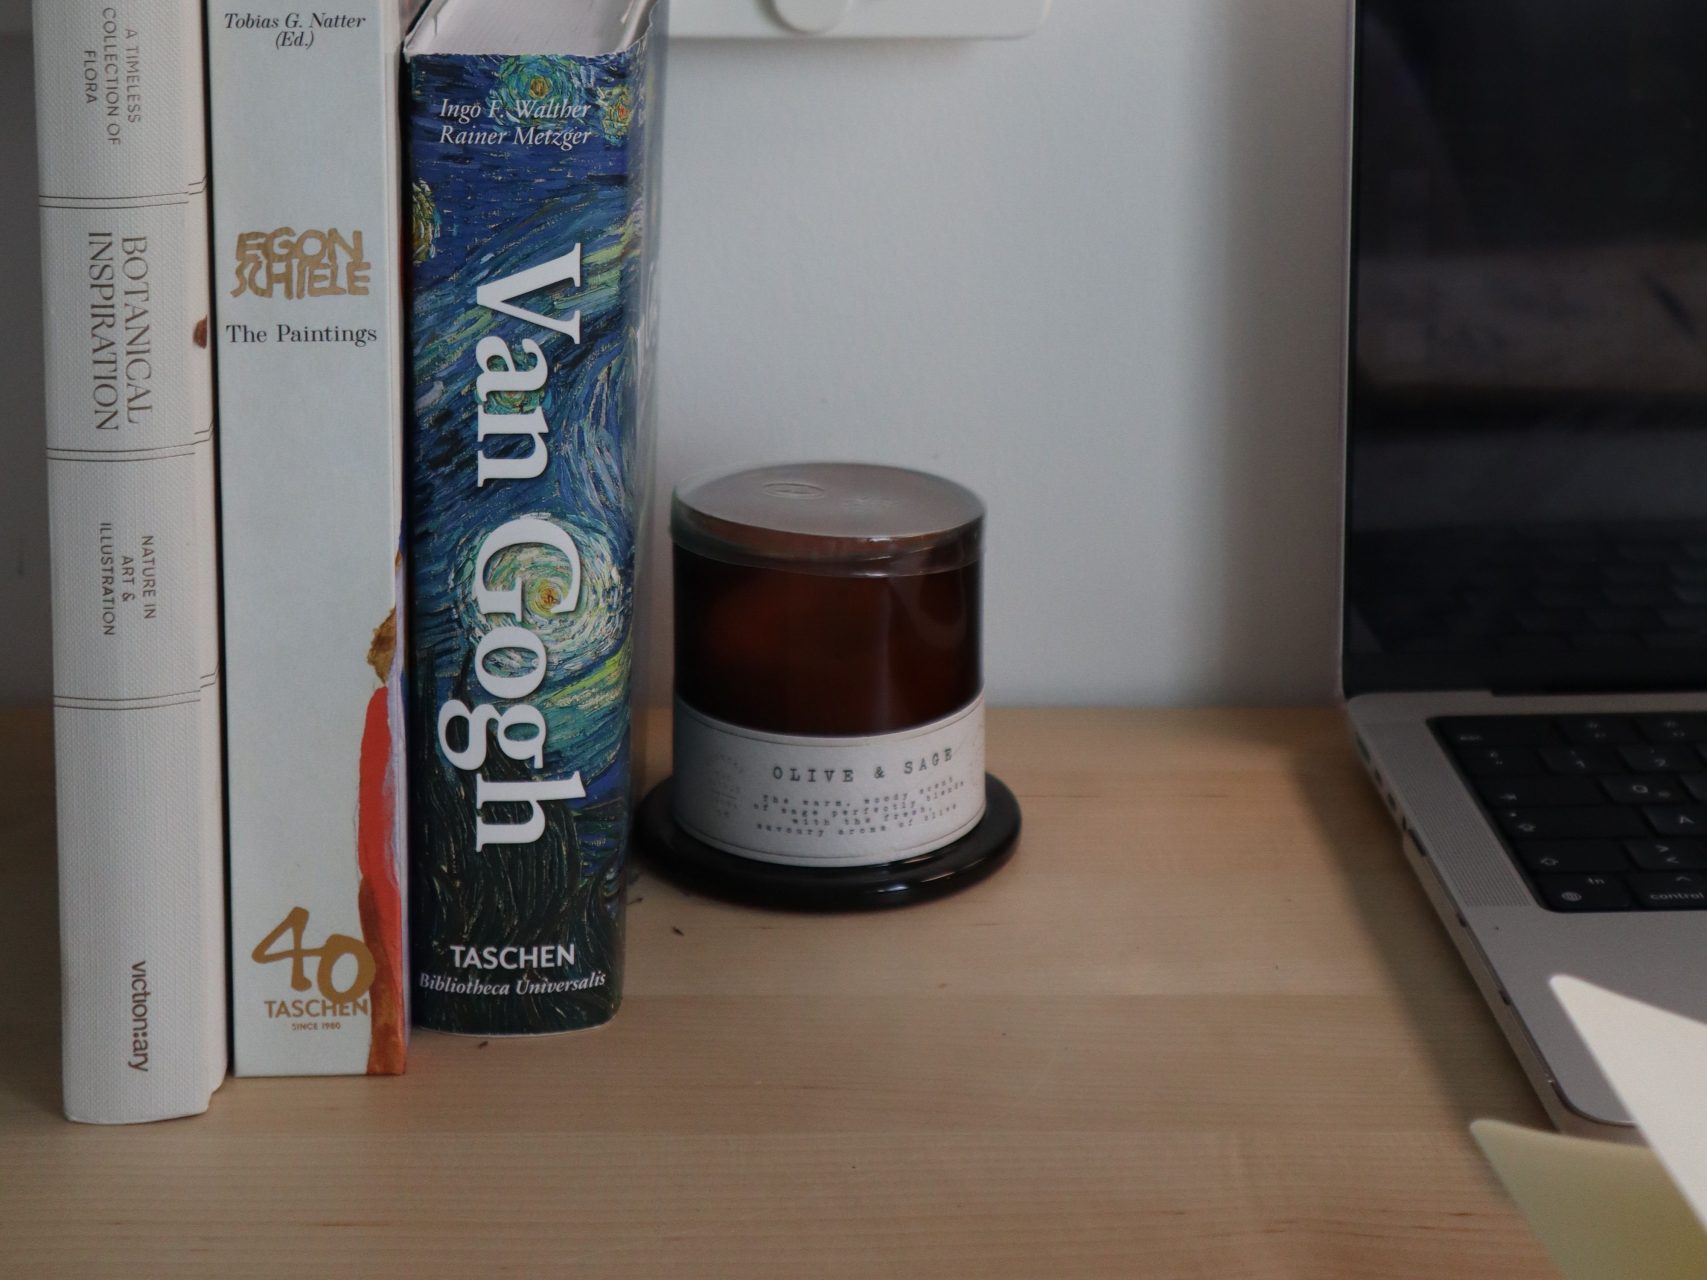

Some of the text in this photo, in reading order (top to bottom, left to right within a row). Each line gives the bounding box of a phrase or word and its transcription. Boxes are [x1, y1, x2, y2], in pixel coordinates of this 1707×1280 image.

[224, 12, 366, 29] Tobias G. Natter
[275, 31, 315, 50] (Ed.)
[83, 50, 98, 104] FLORA
[102, 7, 121, 146] COLLECTION OF
[125, 28, 141, 123] A TIMELESS
[439, 98, 593, 124] Ingo F. Walther
[439, 126, 593, 151] Rainer Metzger
[235, 226, 364, 262] EGON
[230, 254, 371, 300] SCHIELE
[88, 232, 119, 431] INSPIRATION
[121, 235, 153, 424] BOTANICAL
[225, 324, 377, 348] The Paintings
[437, 242, 588, 853] Van Gogh
[100, 522, 116, 636] ILLUSTRATION
[121, 555, 135, 585] ART
[141, 535, 157, 619] NATURE IN
[772, 748, 952, 783] OLIVE & SAGE
[1678, 814, 1695, 825] A
[1586, 876, 1605, 885] fn
[1649, 891, 1705, 901] control
[449, 943, 575, 970] TASCHEN
[419, 970, 606, 996] Bibliotheca Universalis
[128, 960, 152, 1072] viction:ary
[264, 999, 370, 1019] TASCHEN
[291, 1021, 341, 1032] SINCE 1980
